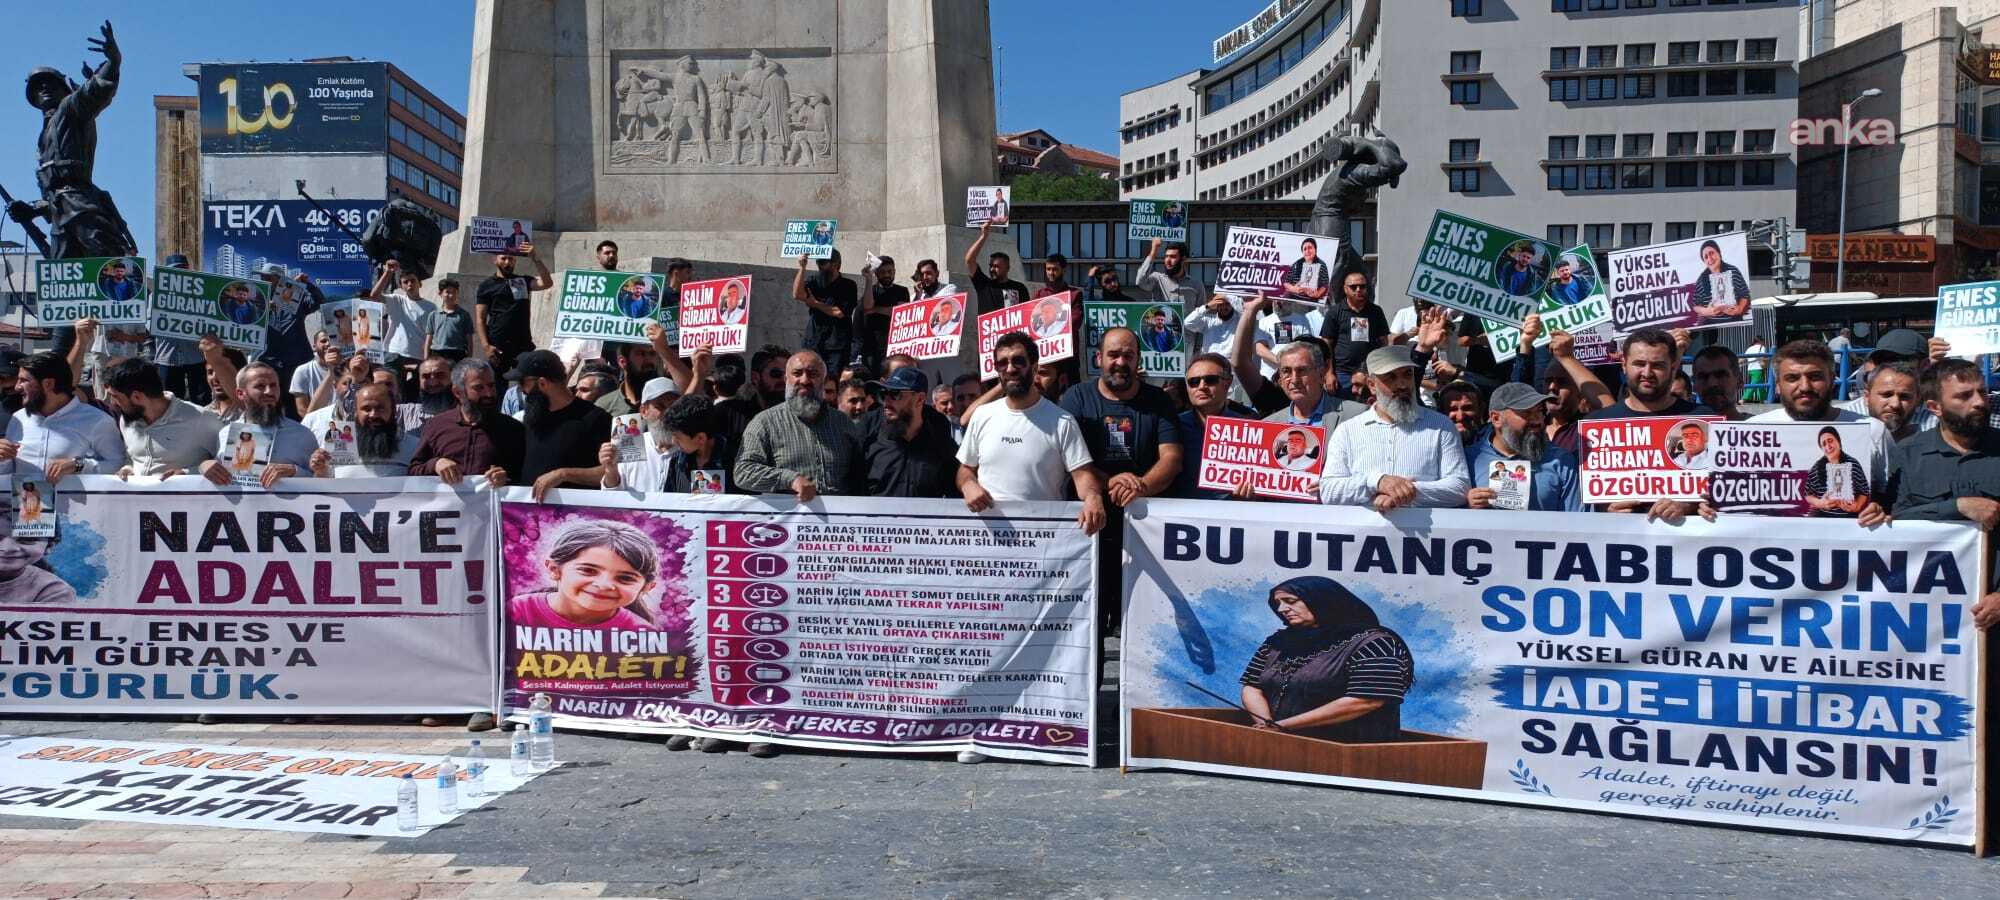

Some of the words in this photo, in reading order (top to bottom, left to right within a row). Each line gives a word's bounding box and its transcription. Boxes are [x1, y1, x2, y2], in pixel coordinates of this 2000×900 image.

[309, 88, 330, 98] 100
[332, 88, 374, 100] Yaşında
[209, 205, 286, 228] TEKA
[1132, 202, 1155, 213] ENES
[788, 222, 808, 232] ENES
[1131, 213, 1161, 225] GÜRAN'A
[1131, 226, 1184, 239] ÖZGÜRLÜK!
[1232, 232, 1277, 249] YÜKSEL
[1434, 219, 1489, 253] ENES
[301, 244, 315, 254] 60
[784, 245, 830, 255] ÖZGÜRLÜK!
[1228, 245, 1281, 263] GÜRAN'A
[40, 263, 83, 281] ENES
[1425, 245, 1493, 281] GÜRAN'A
[1613, 251, 1671, 274] YÜKSEL
[159, 272, 204, 296] ENES
[567, 274, 608, 293] ENES
[1221, 261, 1285, 287] ÖZGÜRLÜK
[1615, 268, 1680, 293] GÜRAN'A
[41, 281, 97, 299] GÜRAN'A
[683, 286, 715, 308] SALİM
[1416, 269, 1533, 322] ÖZGÜRLÜK!
[1943, 286, 1997, 309] ENES
[42, 303, 141, 321] ÖZGÜRLÜK!
[157, 293, 217, 316] GÜRAN'A
[563, 294, 615, 312] GÜRAN'A
[1615, 290, 1693, 325] ÖZGÜRLÜK
[681, 307, 718, 326] GÜRAN'A
[894, 306, 926, 327] SALİM
[982, 310, 1022, 335] SALİM
[1088, 308, 1127, 327] ENES
[157, 314, 261, 344] ÖZGÜRLÜK!
[681, 327, 741, 350] ÖZGÜRLÜK!
[891, 324, 927, 343] GÜRAN'A
[1001, 436, 1022, 444] PRADA
[1210, 423, 1263, 446] SALİM
[1587, 423, 1651, 448] SALİM
[1715, 425, 1782, 448] YÜKSEL
[1207, 442, 1270, 466] GÜRAN'A
[1587, 448, 1665, 470] GÜRAN'A
[1714, 447, 1792, 469] GÜRAN'A
[1204, 464, 1313, 495] ÖZGÜRLÜK!
[1712, 474, 1803, 502] ÖZGÜRLÜK
[139, 504, 463, 554] NARİN'E
[715, 525, 726, 544] 1
[824, 526, 933, 536] ARAŞTIRILMADAN,
[938, 529, 989, 537] KAMERA
[994, 530, 1055, 538] KAYITLARI
[797, 534, 858, 543] OLMADAN,
[863, 536, 911, 544] TELEFON
[915, 535, 971, 546] İMAJLARI
[975, 538, 1036, 548] SİLİNEREK
[714, 554, 730, 574] 2
[797, 555, 823, 563] ADİL
[827, 557, 905, 565] YARGILANMA
[950, 560, 1038, 569] ENGELLENMEZ!
[1163, 522, 1244, 565] BU
[1273, 529, 1493, 585] UTANÇ
[1515, 540, 1967, 595] TABLOSUNA
[797, 564, 845, 572] TELEFON
[849, 565, 902, 574] İMAJLARI
[905, 566, 952, 577] SİLİNDİ,
[955, 568, 1005, 577] KAMERA
[1010, 570, 1070, 578] KAYITLARI
[797, 573, 836, 581] KAYIP!
[137, 559, 486, 605] ADALET!
[714, 584, 730, 603] 3
[797, 587, 834, 596] NARİN
[838, 588, 861, 598] İÇİN
[865, 589, 908, 598] ADALET
[911, 590, 953, 600] SOMUT
[956, 592, 1001, 601] DELİLER
[1005, 593, 1087, 604] ARAŞTIRILSIN,
[797, 597, 823, 605] ADİL
[827, 598, 893, 607] YARGILAMA
[896, 600, 943, 609] TEKRAR
[946, 602, 1004, 611] YAPILSIN!
[713, 613, 730, 632] 4
[798, 616, 831, 625] EKSİK
[835, 617, 849, 625] VE
[853, 618, 893, 628] YANLIŞ
[896, 619, 955, 630] DELİLERLE
[959, 622, 1026, 631] YARGILAMA
[1030, 624, 1072, 632] OLMAZ!
[1480, 585, 1643, 640] SON
[1669, 593, 1963, 656] VERİN!
[149, 621, 270, 642] ENES
[286, 622, 345, 643] VE
[516, 625, 603, 653] NARİN
[611, 628, 668, 657] İÇİN
[798, 625, 843, 635] GERÇEK
[847, 627, 879, 636] KATİL
[883, 628, 928, 638] ORTAYA
[932, 631, 1004, 641] ÇIKARILSIN!
[95, 641, 318, 667] GÜRAN'A
[714, 639, 730, 658] 5
[800, 642, 841, 651] ADALET
[845, 643, 908, 654] İSTİYORUZ!
[912, 646, 956, 657] GERÇEK
[960, 648, 992, 657] KATİL
[516, 652, 688, 680] ADALET!
[800, 651, 843, 660] ORTADA
[847, 653, 869, 662] YOK
[872, 654, 915, 663] DELİLER
[918, 656, 940, 665] YOK
[943, 657, 990, 667] SAYILDI!
[1516, 638, 1629, 664] YÜKSEL
[1641, 645, 1749, 670] GÜRAN
[1759, 653, 1798, 674] VE
[1808, 656, 1946, 682] AİLESİNE
[715, 663, 731, 682] 6
[800, 666, 835, 676] NARİN
[839, 668, 861, 678] İÇİN
[865, 670, 908, 680] GERÇEK
[910, 672, 954, 682] ADALET!
[958, 674, 1002, 683] DELİLER
[801, 675, 864, 686] YARGILAMA
[867, 679, 938, 690] YENİLENSİN!
[523, 680, 553, 689] Sessiz
[717, 688, 731, 703] 7
[802, 690, 855, 700] ADALETİN
[858, 692, 885, 702] ÜSTÜ
[888, 694, 968, 706] ÖRTÜLENMEZ!
[1522, 668, 1713, 720] İADE-İ
[1737, 682, 1943, 736] İTİBAR
[559, 697, 625, 717] NARİN
[633, 701, 680, 723] İÇİN
[786, 715, 877, 735] HERKES
[884, 718, 934, 740] İÇİN
[941, 722, 1040, 740] ADALET!
[802, 698, 843, 708] TELEFON
[847, 701, 897, 712] KAYITLARI
[899, 704, 940, 715] SİLİNDİ,
[943, 706, 987, 714] KAMERA
[1059, 711, 1083, 720] YOK!
[1521, 718, 1939, 787] SAĞLANSIN!
[62, 769, 307, 796] KATİL
[1578, 765, 1676, 789] Adalet,
[1684, 774, 1781, 801] iftirayı
[1786, 783, 1861, 807] değil,
[1598, 787, 1697, 810] gerçeği
[1704, 796, 1841, 823] sahiplenir.
